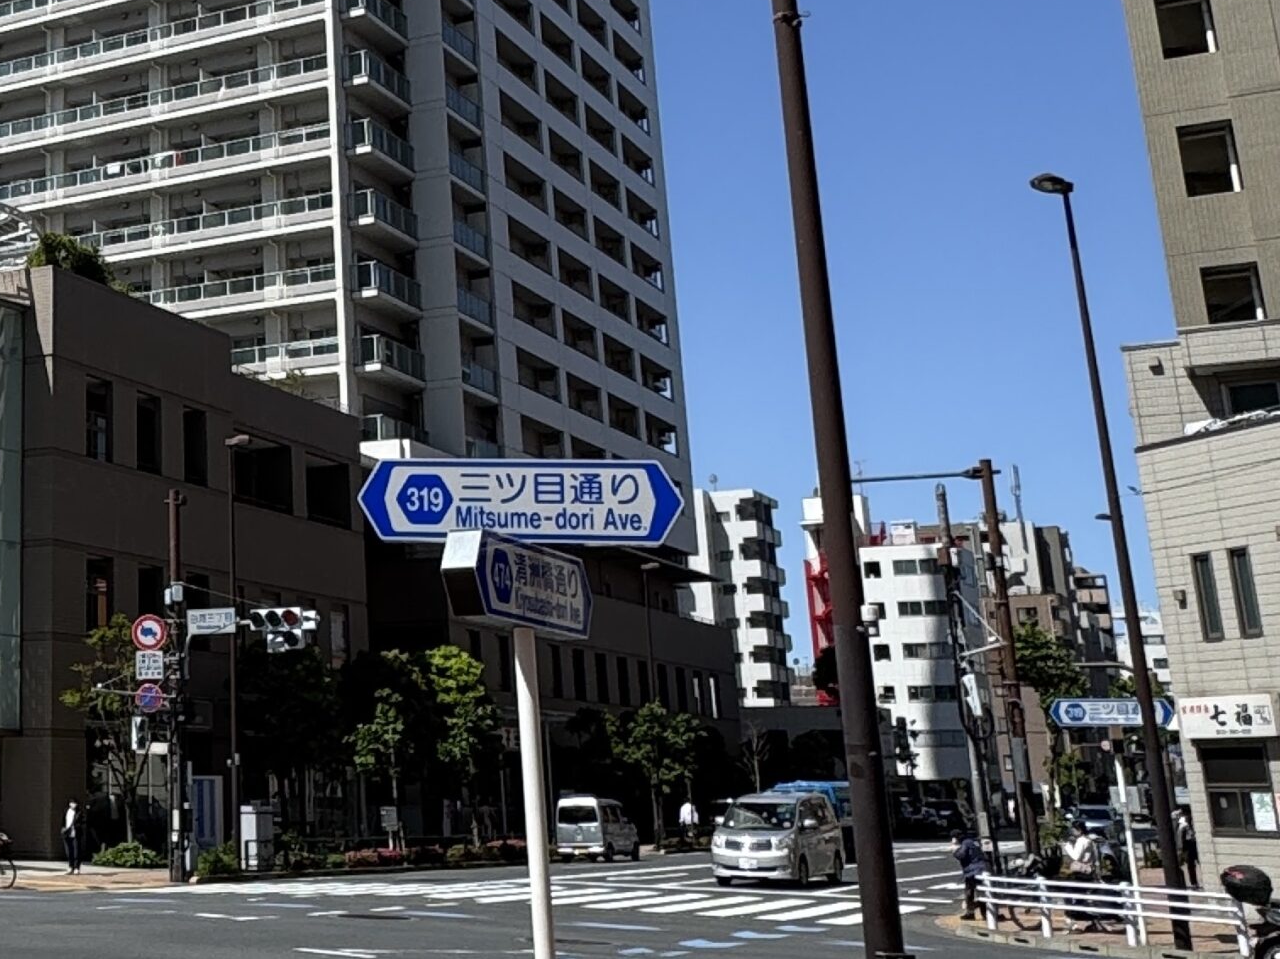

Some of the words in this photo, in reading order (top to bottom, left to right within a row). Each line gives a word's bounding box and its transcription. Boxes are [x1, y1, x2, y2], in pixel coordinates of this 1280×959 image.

[405, 487, 444, 512] 319
[458, 473, 640, 505] 三ツ目通り
[455, 506, 595, 531] Mitsume-dori
[603, 509, 648, 532] Ave.
[493, 562, 512, 591] 474
[1210, 703, 1253, 727] 七福
